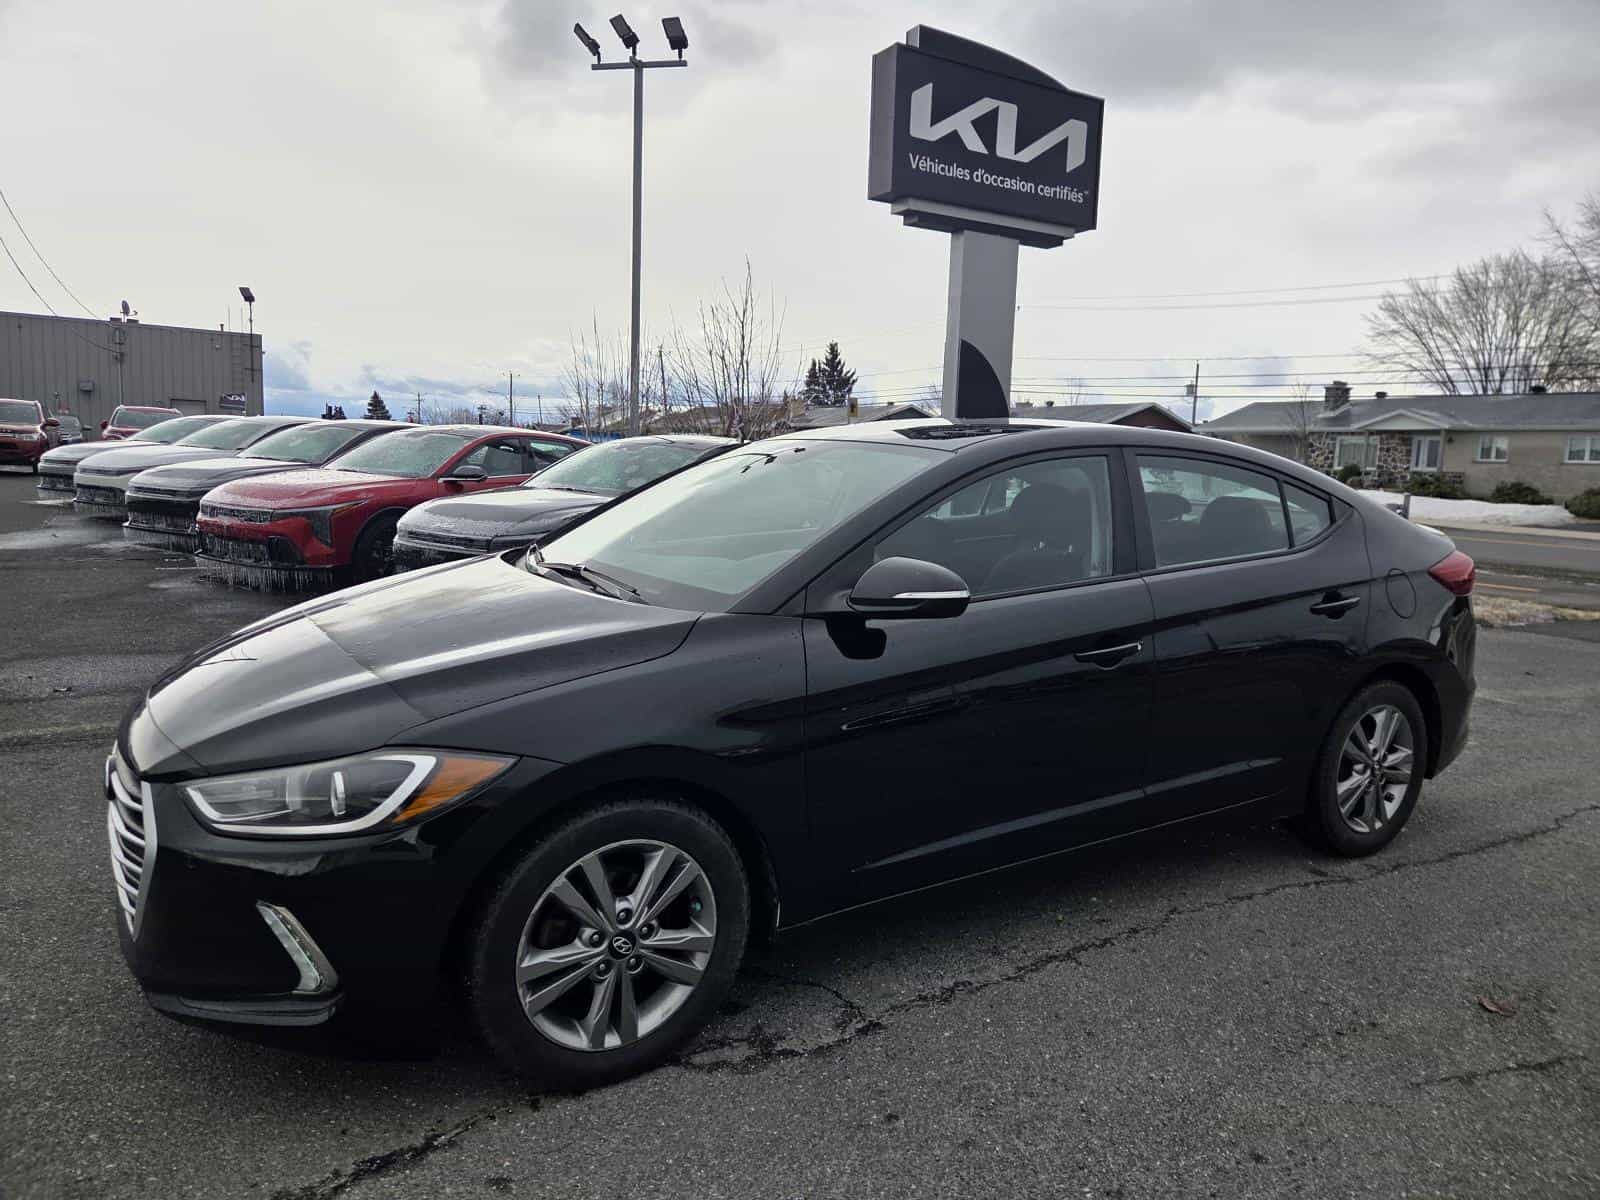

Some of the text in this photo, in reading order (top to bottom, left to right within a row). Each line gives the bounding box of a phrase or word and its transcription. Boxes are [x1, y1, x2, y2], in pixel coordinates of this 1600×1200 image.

[909, 82, 1087, 173] KIA
[909, 152, 1083, 203] Véhicules d'occasion certifiés
